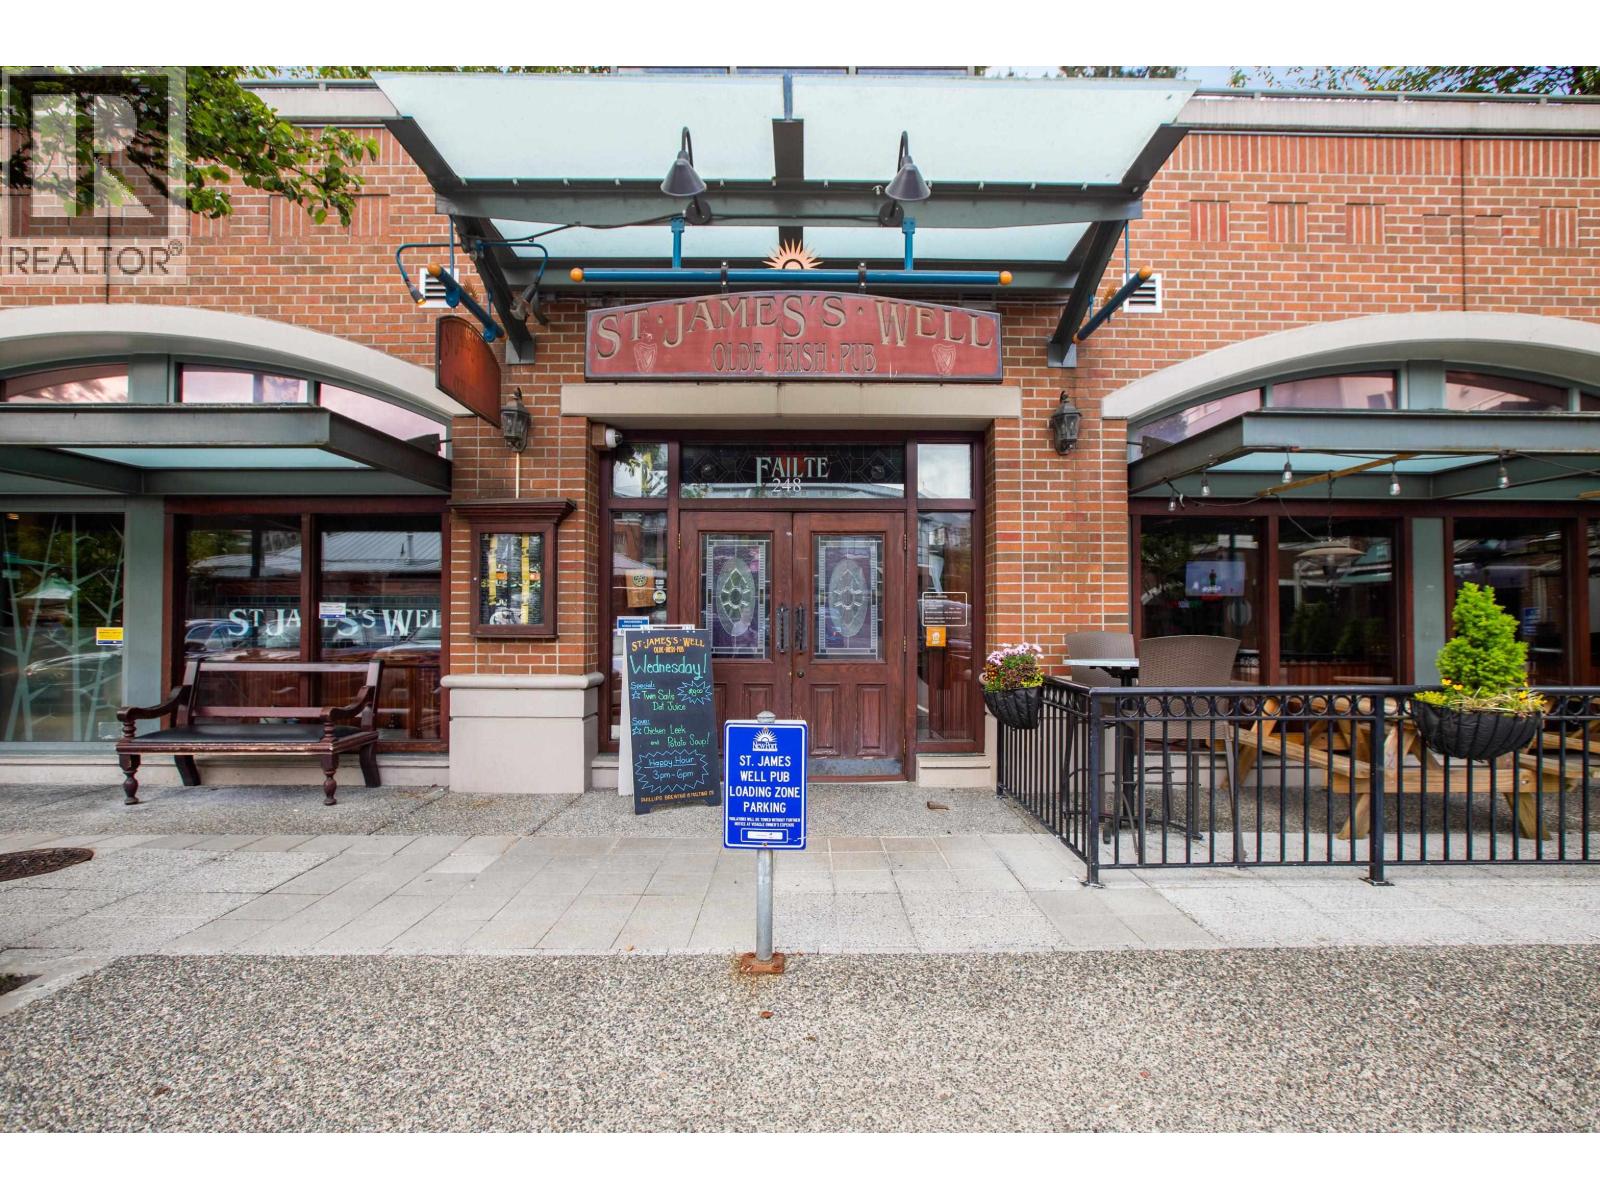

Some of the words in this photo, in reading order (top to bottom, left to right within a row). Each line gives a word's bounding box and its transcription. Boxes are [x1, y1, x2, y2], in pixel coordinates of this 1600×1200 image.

[594, 307, 649, 361] ST
[662, 295, 847, 349] JAMES'S
[875, 299, 993, 350] WELL
[711, 342, 763, 373] OLDE
[776, 342, 828, 373] IRISH
[839, 342, 877, 373] PUB
[755, 456, 831, 487] FAILTE
[772, 477, 802, 493] 248
[228, 608, 264, 636] ST
[265, 608, 376, 636] JAS'S
[382, 608, 441, 637] WEL
[631, 640, 642, 652] ST
[643, 636, 679, 649] JAMES'S
[682, 637, 705, 648] WELL
[629, 653, 707, 681] Wednesday!
[667, 701, 687, 711] Juice
[643, 726, 667, 735] Chicken
[667, 736, 687, 748] Potato
[689, 731, 711, 747] Soup!
[648, 758, 673, 768] Happy
[675, 756, 695, 764] Hour
[739, 755, 754, 767] ST.
[757, 756, 792, 767] JAMES
[740, 770, 767, 782] WELL
[770, 771, 790, 783] PUB
[729, 785, 772, 798] LOADING
[774, 786, 801, 798] ZONE
[743, 801, 787, 813] PARKING
